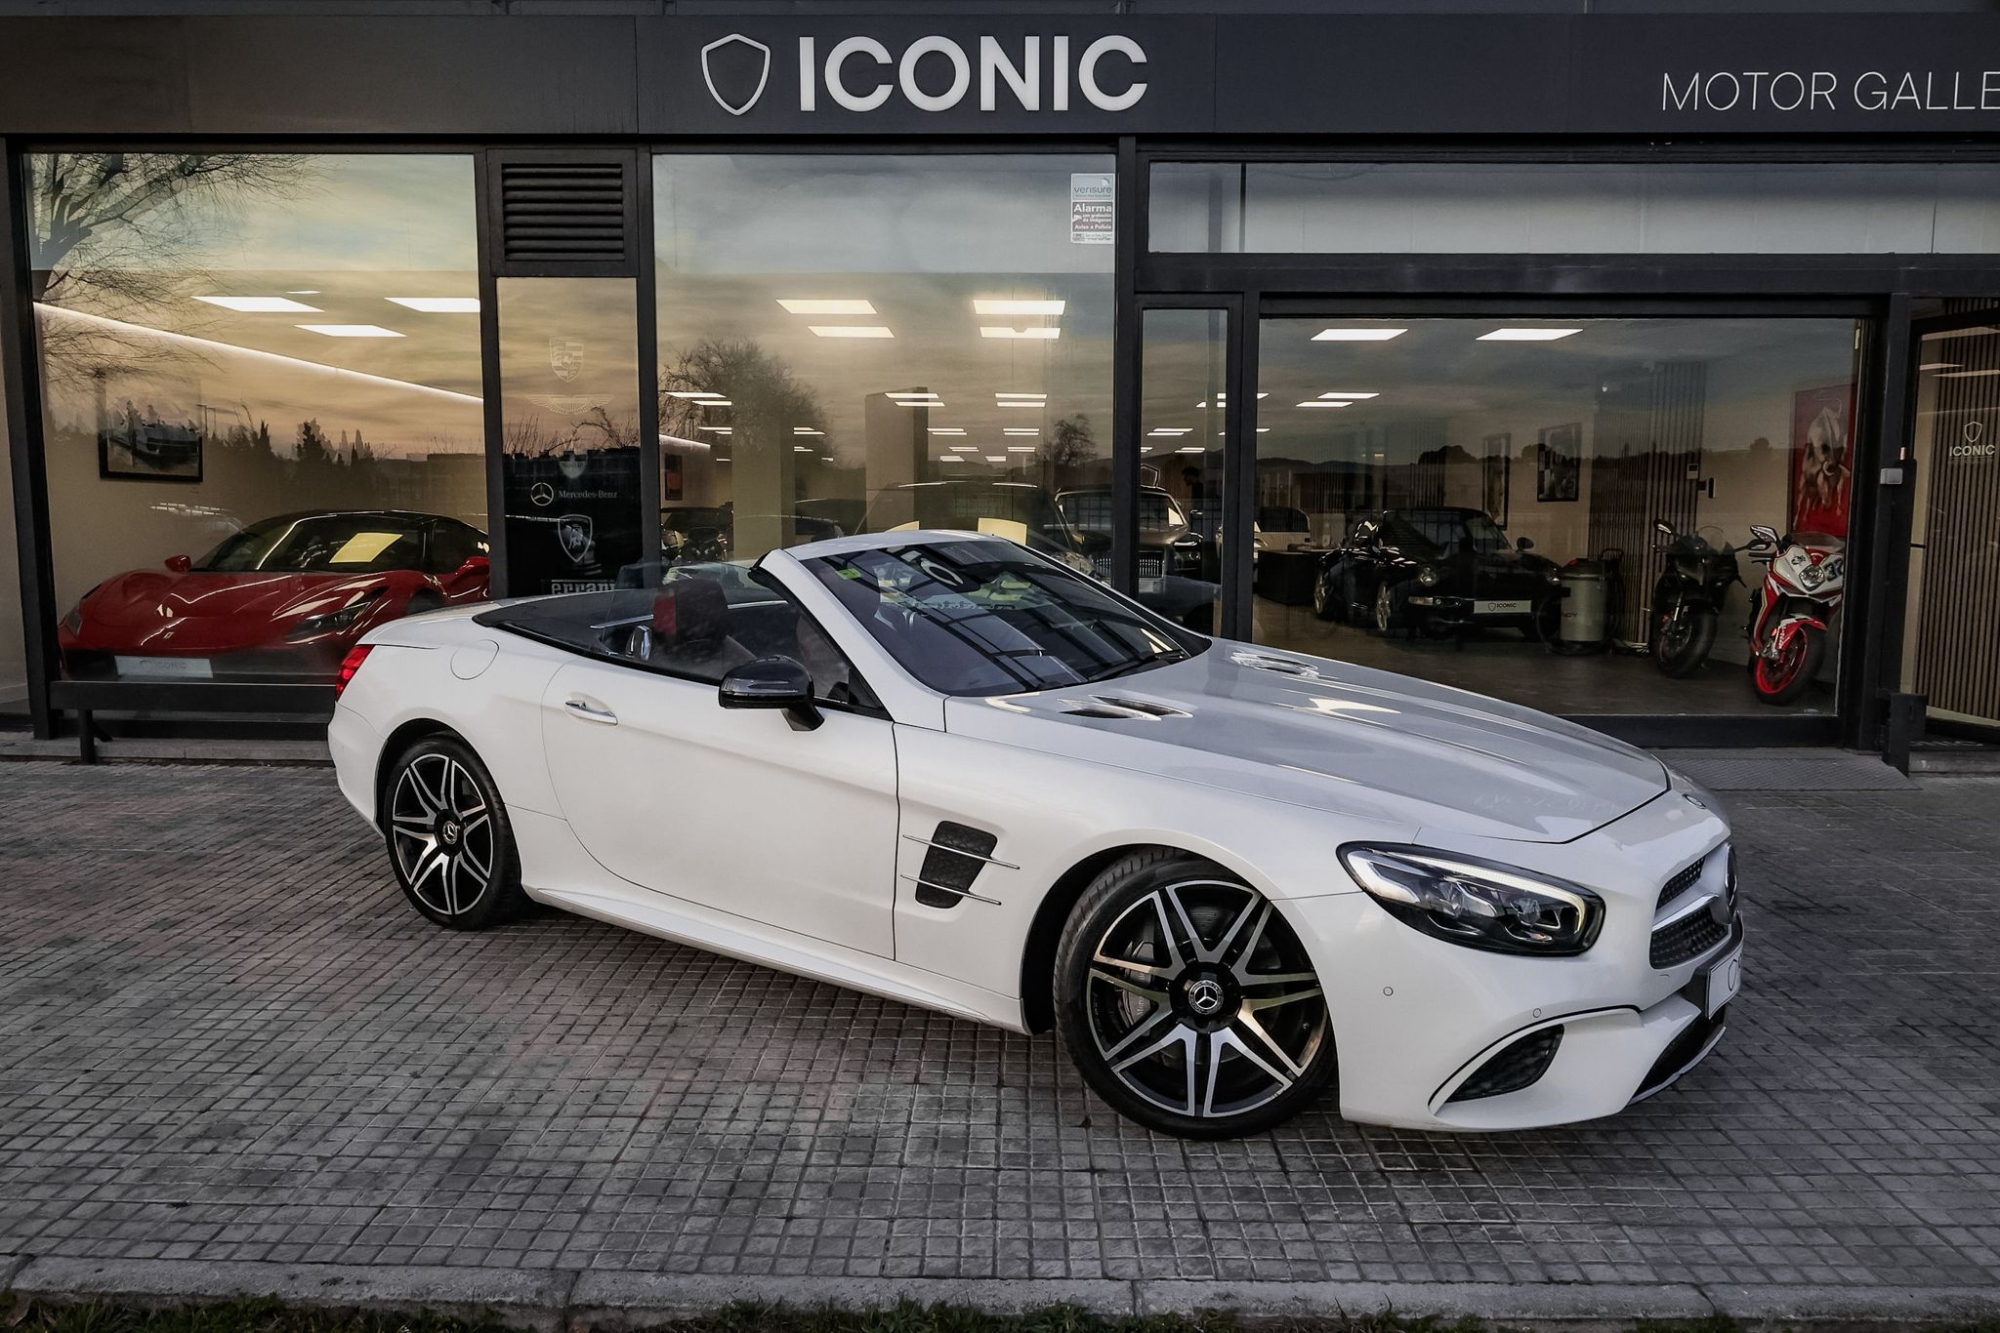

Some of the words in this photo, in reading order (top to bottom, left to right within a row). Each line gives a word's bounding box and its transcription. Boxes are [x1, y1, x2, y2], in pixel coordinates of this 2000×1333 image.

[798, 34, 1149, 113] ICONIC
[1662, 71, 1838, 111] MOTOR
[1853, 71, 2000, 111] GALLE
[1073, 186, 1112, 194] verisure
[1073, 203, 1112, 213] Alarma
[1949, 444, 1995, 457] ICONIC
[558, 490, 618, 499] Mercedes-Benz
